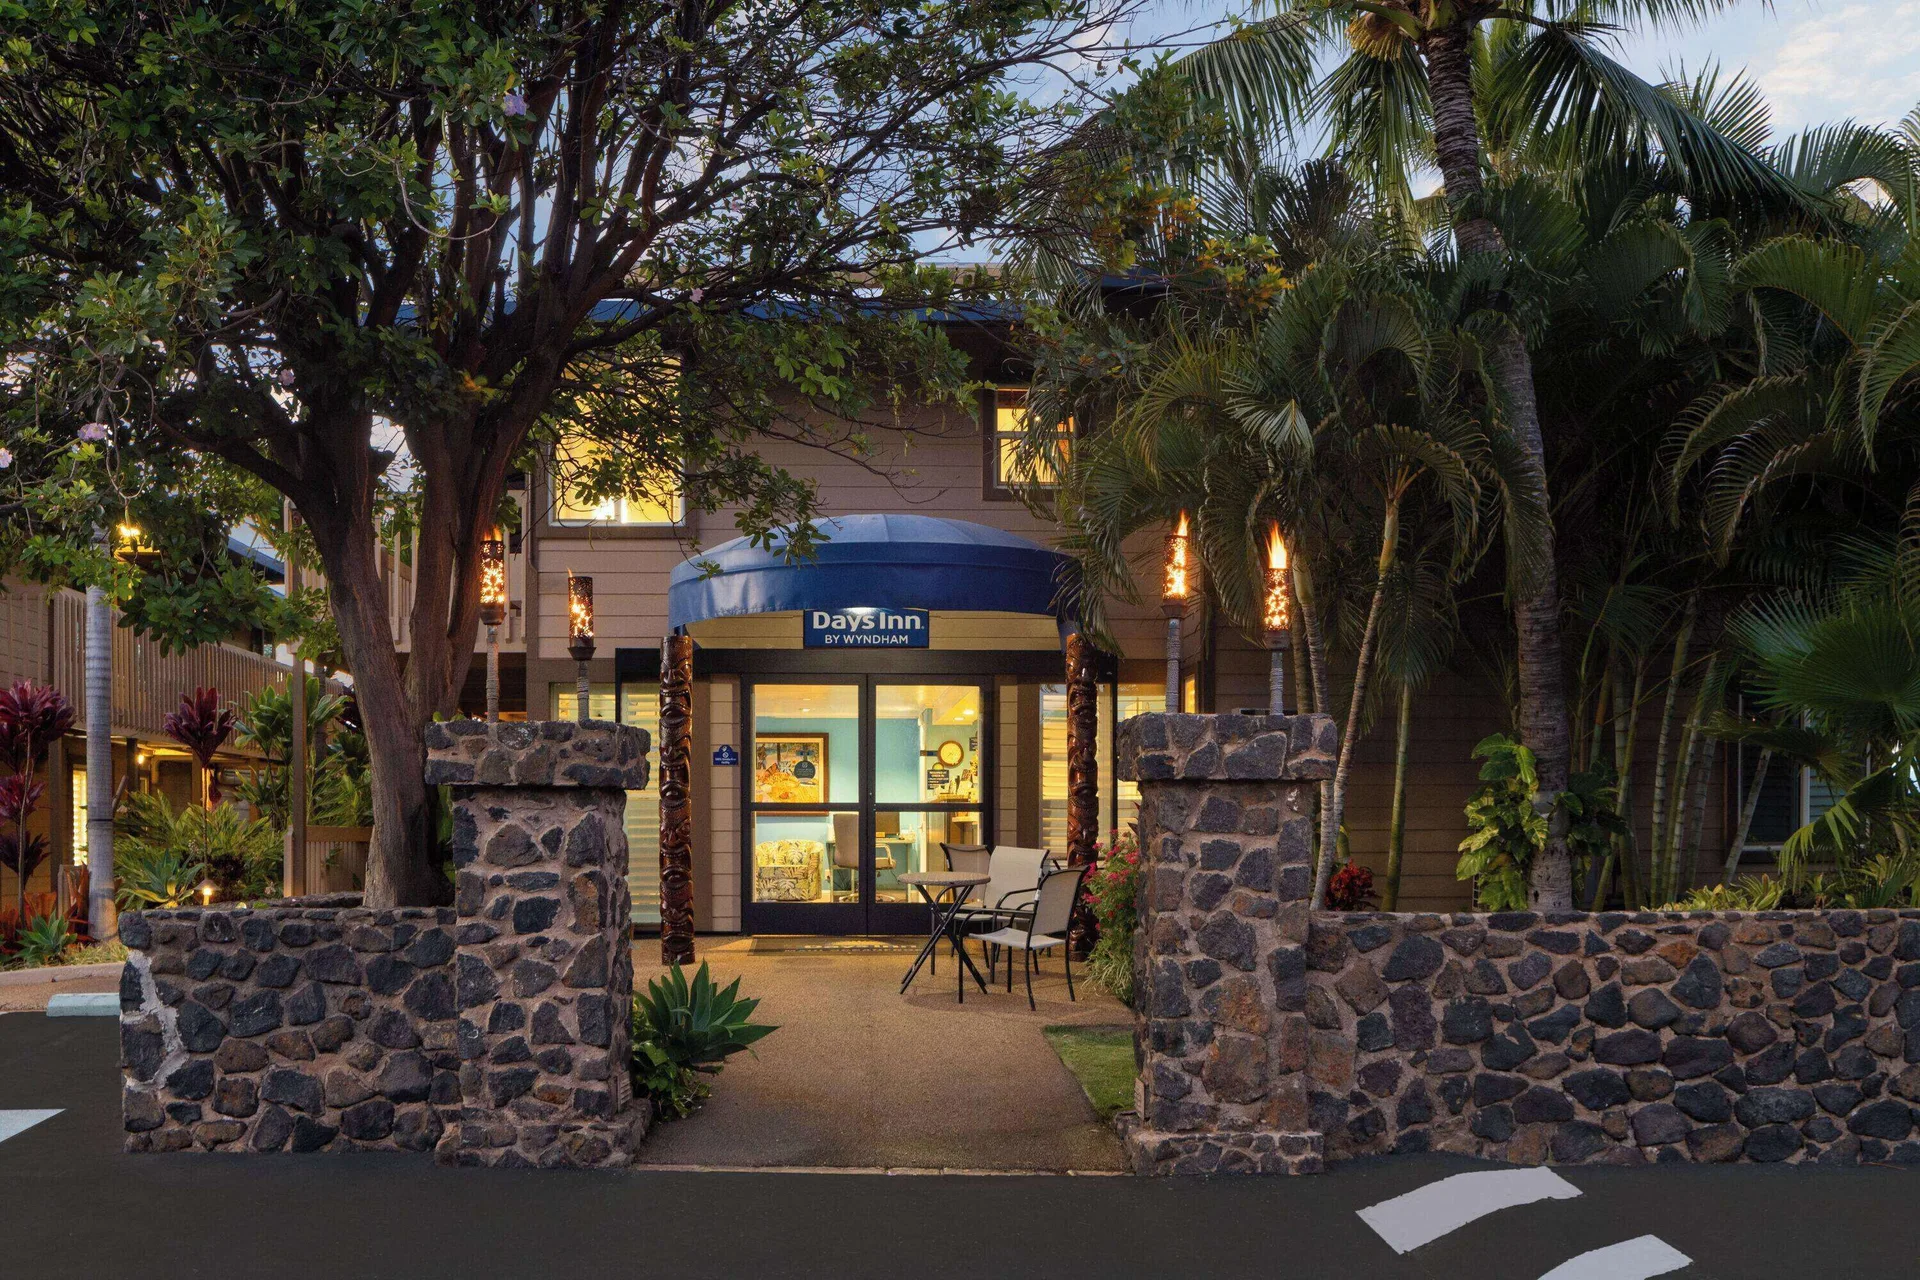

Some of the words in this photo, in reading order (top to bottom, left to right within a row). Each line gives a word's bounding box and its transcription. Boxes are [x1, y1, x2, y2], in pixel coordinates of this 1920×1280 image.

[813, 611, 875, 632] Days
[879, 611, 921, 630] Inn
[825, 634, 840, 644] BY
[843, 634, 909, 644] WYNDHAM
